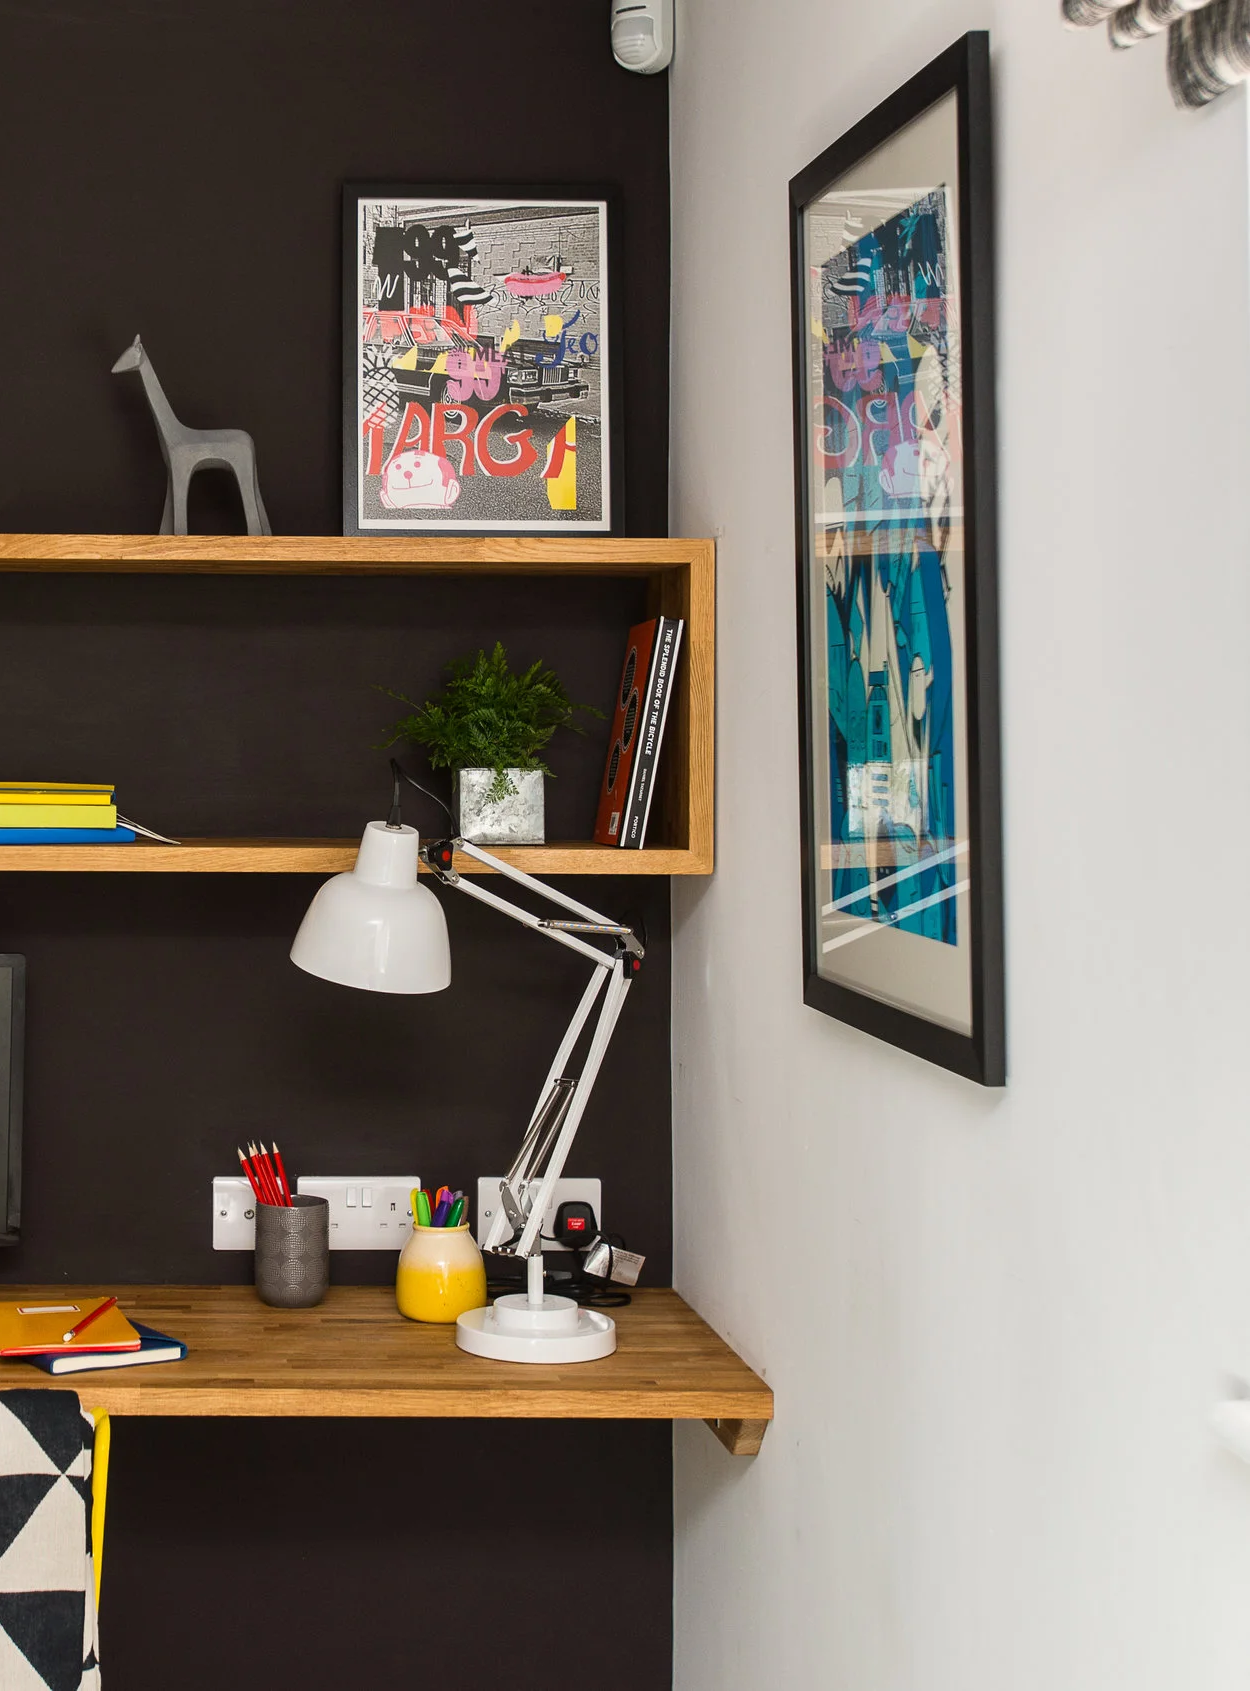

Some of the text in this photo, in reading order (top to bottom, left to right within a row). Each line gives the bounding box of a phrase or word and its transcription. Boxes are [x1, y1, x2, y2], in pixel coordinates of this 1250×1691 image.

[645, 628, 673, 755] THE SPLENDID BOOK OF THE BICYCLE
[631, 815, 639, 838] PORTICO
